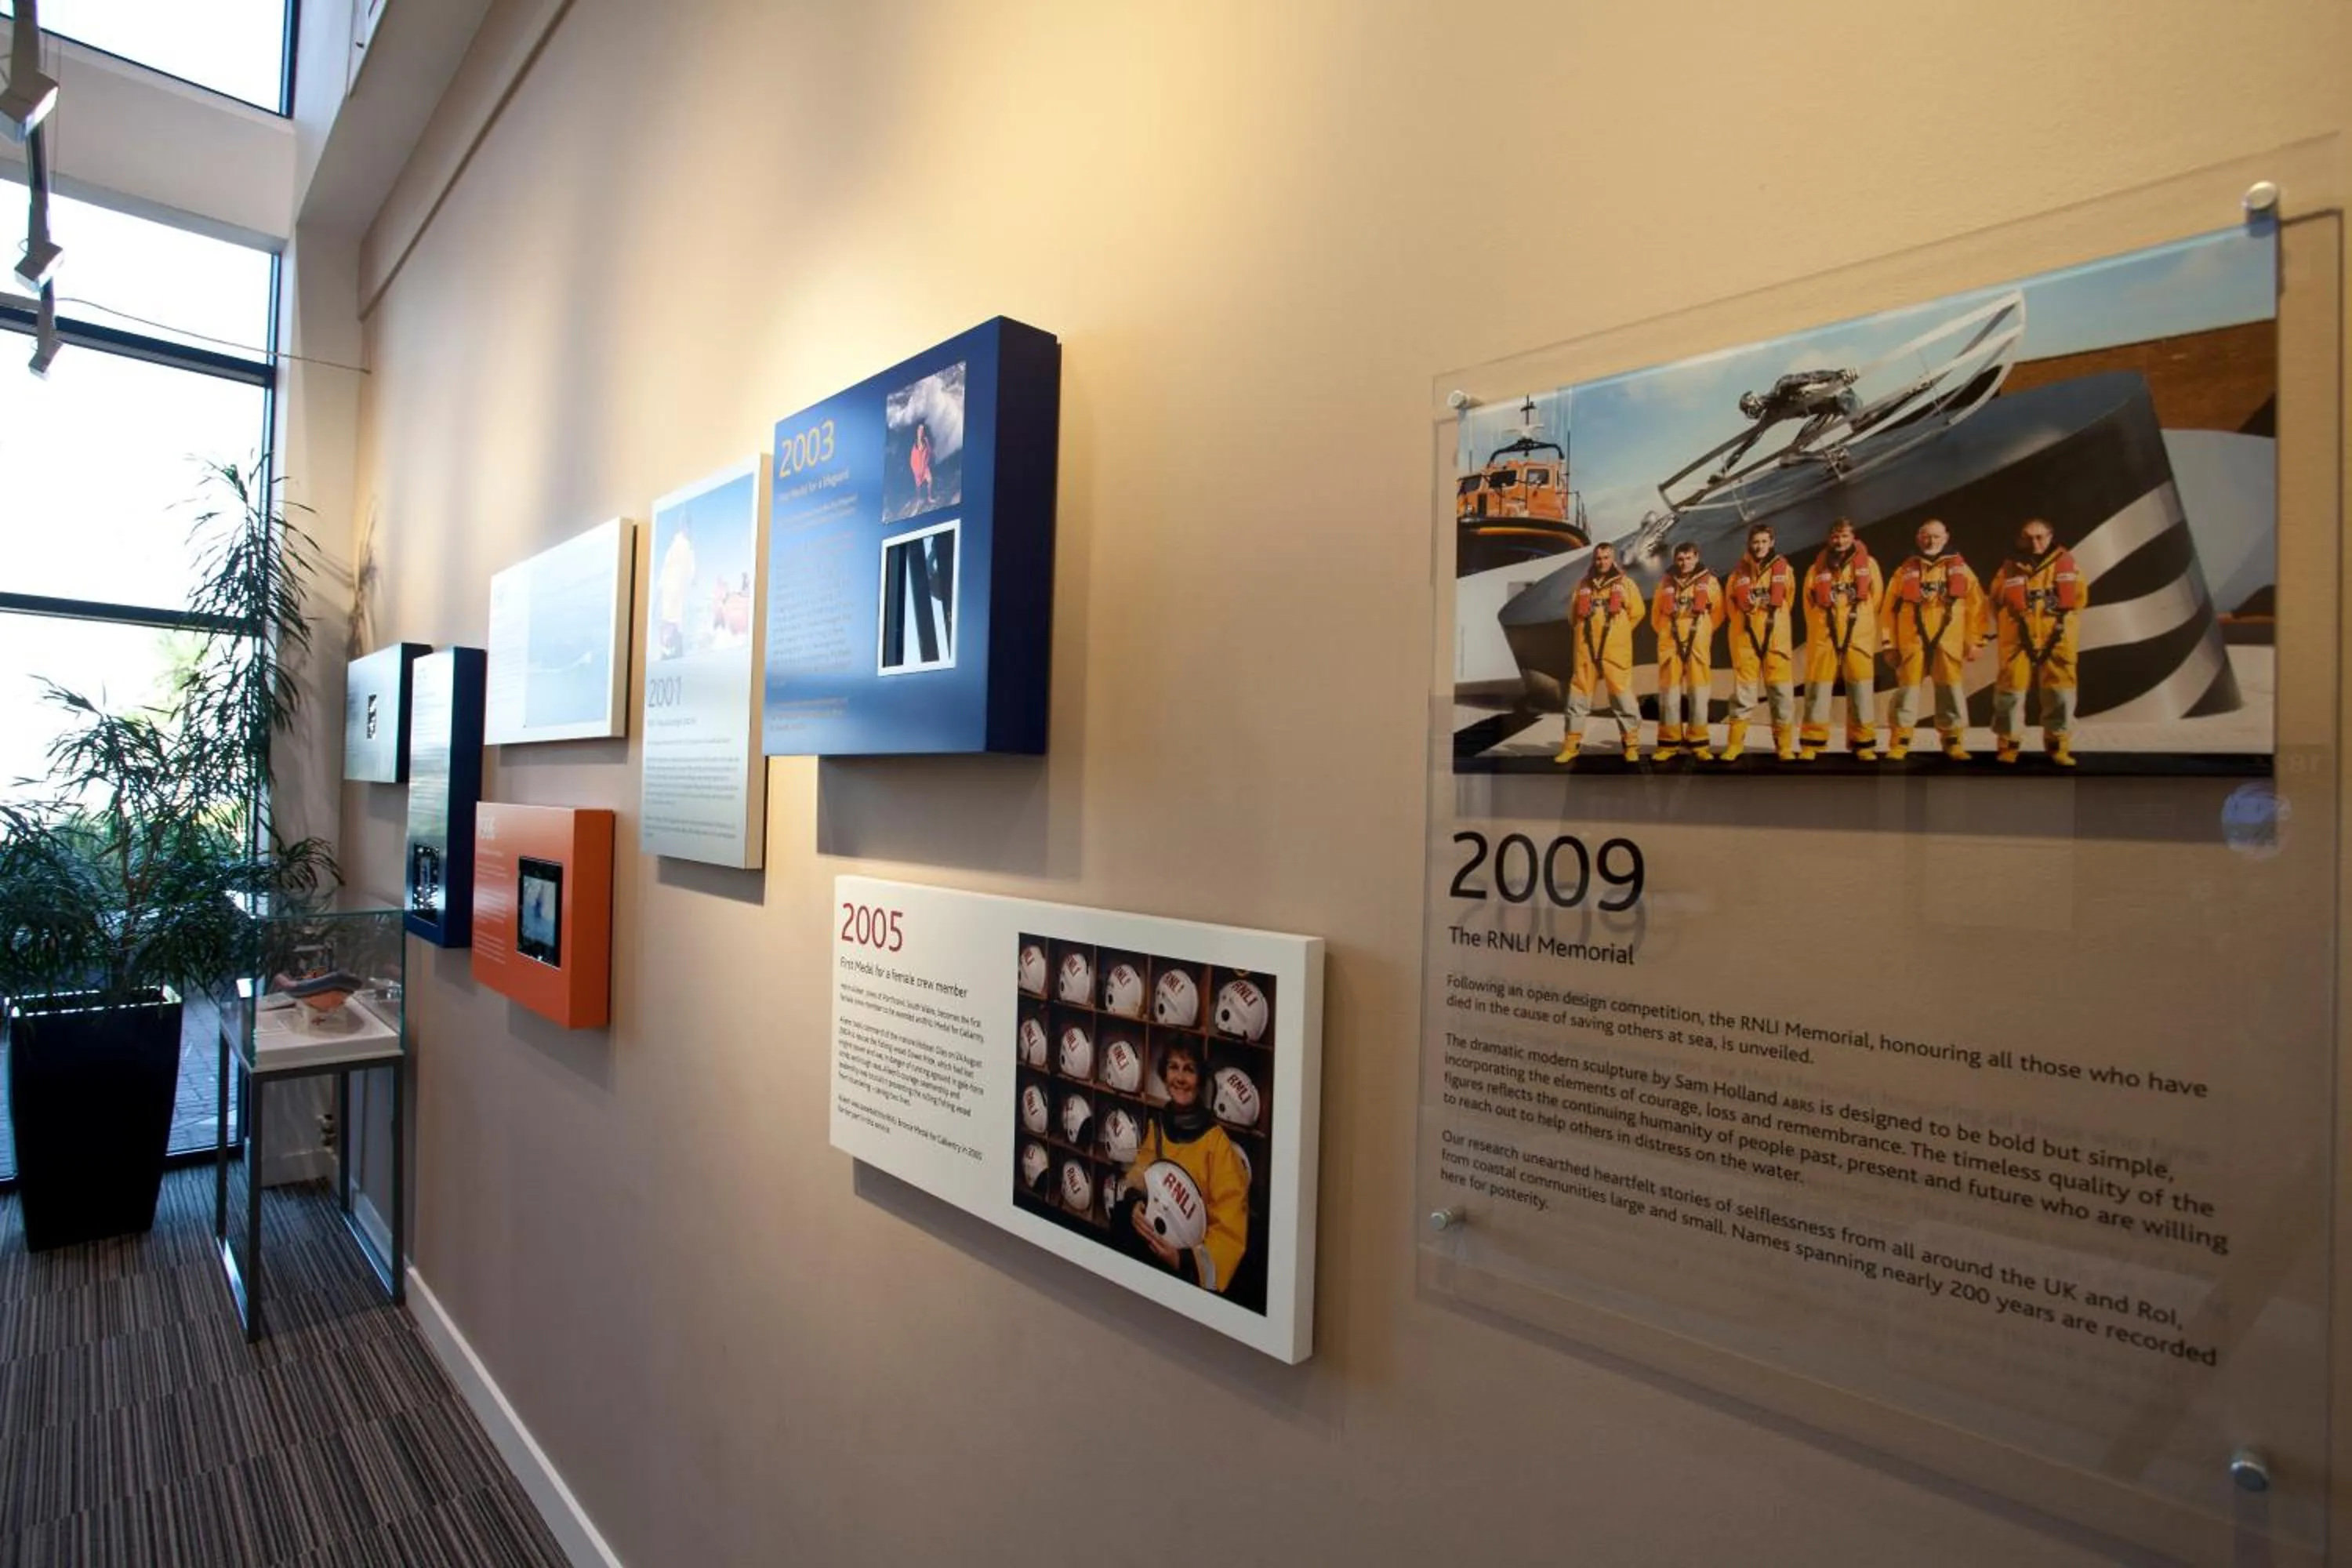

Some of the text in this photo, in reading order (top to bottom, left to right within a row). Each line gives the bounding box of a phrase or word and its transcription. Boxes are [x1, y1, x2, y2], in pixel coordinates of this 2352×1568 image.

[779, 419, 835, 477] 2003
[648, 676, 682, 707] 2001
[1450, 831, 1645, 912] 2009
[841, 902, 903, 952] 2005
[1449, 927, 1635, 965] The RNLI Memorial
[936, 981, 968, 998] member
[1231, 981, 1258, 1007] RNLI
[1446, 993, 1813, 1064] died in the cause of saving others at sea, is unveiled.
[1446, 974, 2208, 1098] Following an open design competition, the RNLI Memorial, honouring all those who have
[1227, 1074, 1252, 1105] RNLI
[1445, 1032, 1466, 1048] The
[1470, 1037, 1523, 1059] dramatic
[1527, 1051, 1578, 1069] modern
[1582, 1060, 1647, 1082] sculpture
[1651, 1069, 1671, 1089] by
[1675, 1073, 1708, 1093] Sam
[1713, 1081, 1777, 1106] Holland
[1820, 1099, 1833, 1116] is
[1838, 1103, 1922, 1133] designed
[1929, 1120, 1950, 1138] to
[1957, 1123, 1980, 1143] be
[1988, 1128, 2034, 1153] bold
[2042, 1138, 2080, 1163] but
[2089, 1149, 2173, 1182] simple,
[1443, 1092, 1804, 1184] to reach out to help others in distress on the water.
[1443, 1071, 2228, 1255] figures reflects the continuing humanity of people past, present and future who are willing
[1444, 1051, 2214, 1217] incorporating the elements of courage, loss and remembrance. The timeless quality of the
[1163, 1172, 1197, 1221] RNLI
[1440, 1167, 1548, 1211] here for posterity.
[1441, 1129, 1465, 1145] Our
[1468, 1138, 1519, 1160] research
[1522, 1152, 1589, 1178] unearthed
[1594, 1166, 1655, 1195] heartfelt
[1660, 1185, 1711, 1208] stories
[1715, 1198, 1732, 1212] of
[1736, 1204, 1835, 1239] selflessness
[1841, 1226, 1886, 1252] from
[1892, 1241, 1914, 1259] all
[1921, 1250, 1993, 1279] around
[2000, 1267, 2035, 1290] the
[2044, 1277, 2077, 1300] UK
[2085, 1291, 2129, 1313] and
[1441, 1147, 2216, 1367] from coastal communities large and small. Names spanning nearly 200 years are recorded
